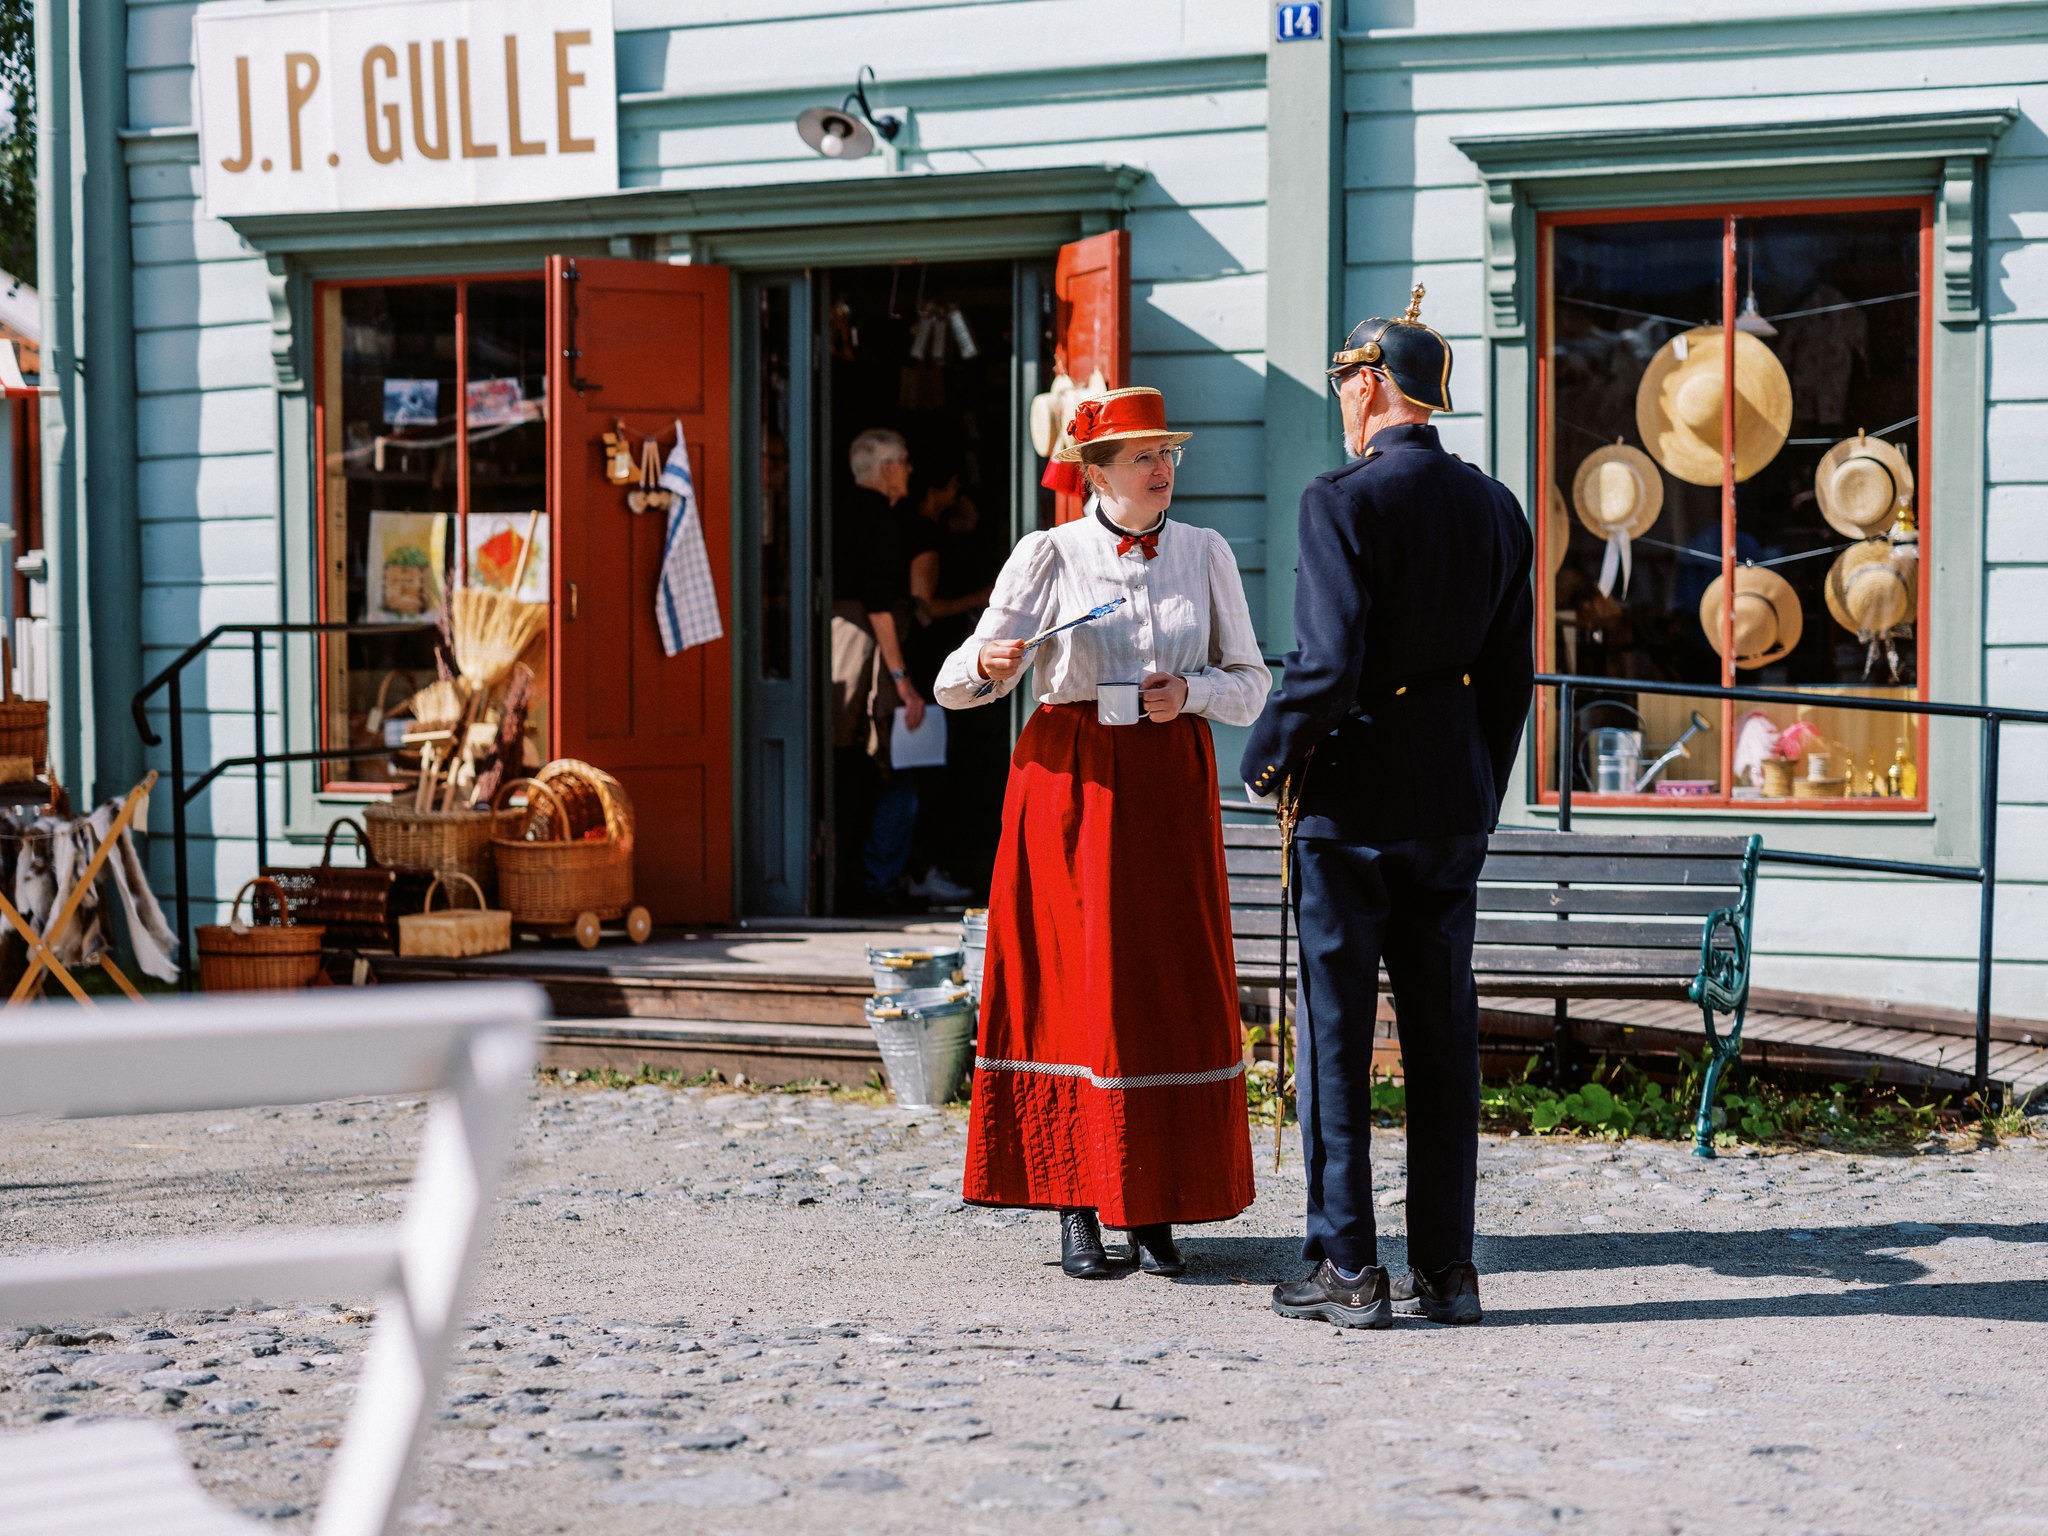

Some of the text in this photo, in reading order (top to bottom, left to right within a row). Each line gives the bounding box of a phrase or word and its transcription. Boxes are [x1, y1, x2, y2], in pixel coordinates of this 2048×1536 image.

[1283, 5, 1313, 36] 14
[220, 29, 596, 174] J.P. GULLE
